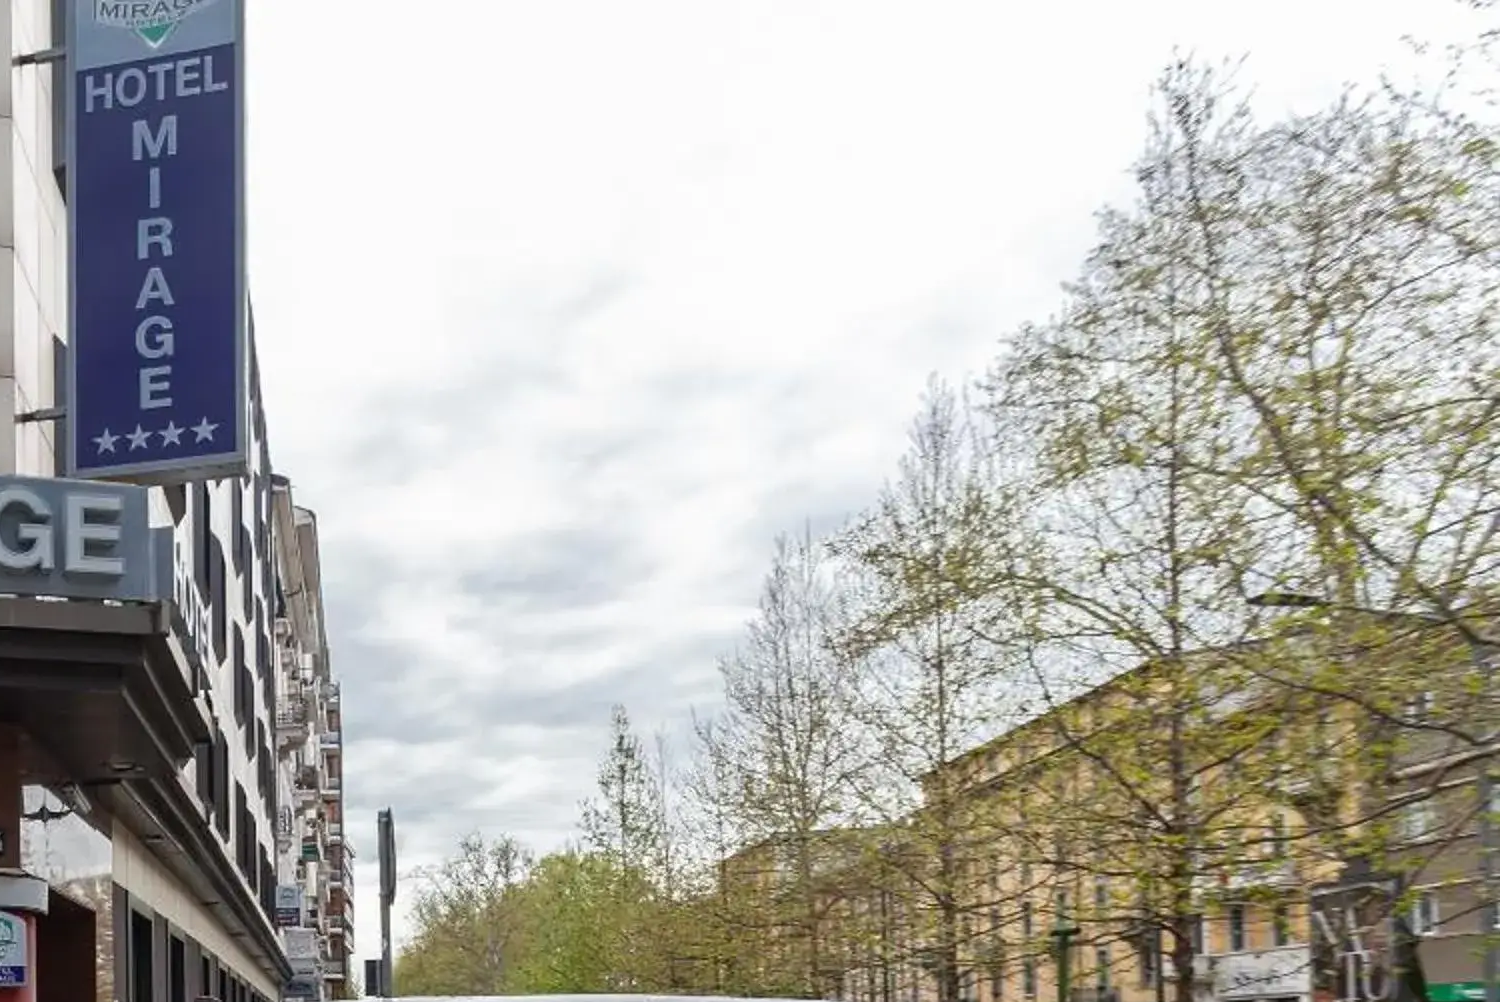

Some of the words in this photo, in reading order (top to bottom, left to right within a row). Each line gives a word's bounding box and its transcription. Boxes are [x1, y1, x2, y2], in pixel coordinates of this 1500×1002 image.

[99, 0, 200, 19] MIRAG
[85, 55, 228, 112] HOTEL
[132, 115, 177, 411] MIRAGE
